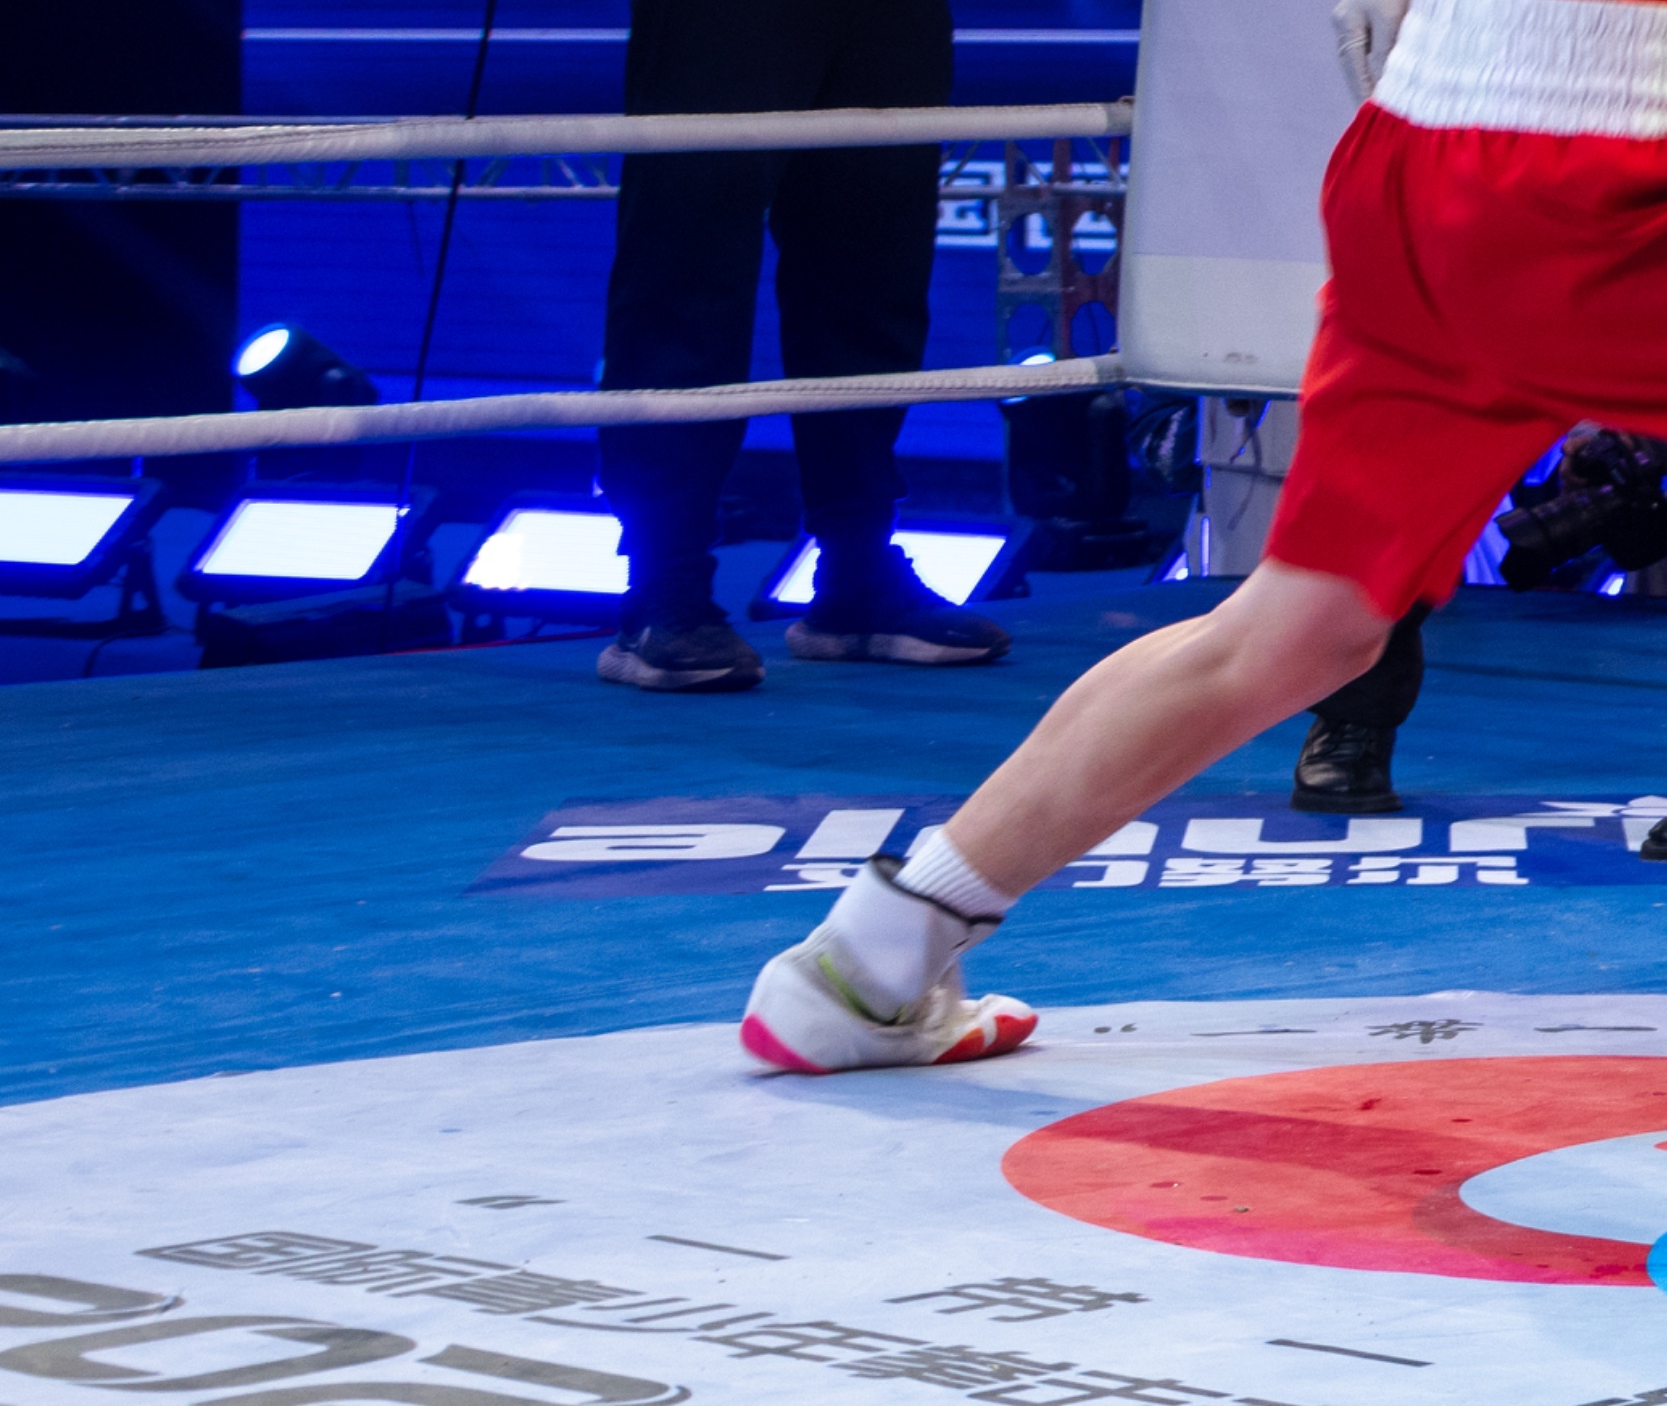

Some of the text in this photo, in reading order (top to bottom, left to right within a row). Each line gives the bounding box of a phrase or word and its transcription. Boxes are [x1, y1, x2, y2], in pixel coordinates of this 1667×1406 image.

[136, 1230, 1310, 1406] 国际青少年拳击
